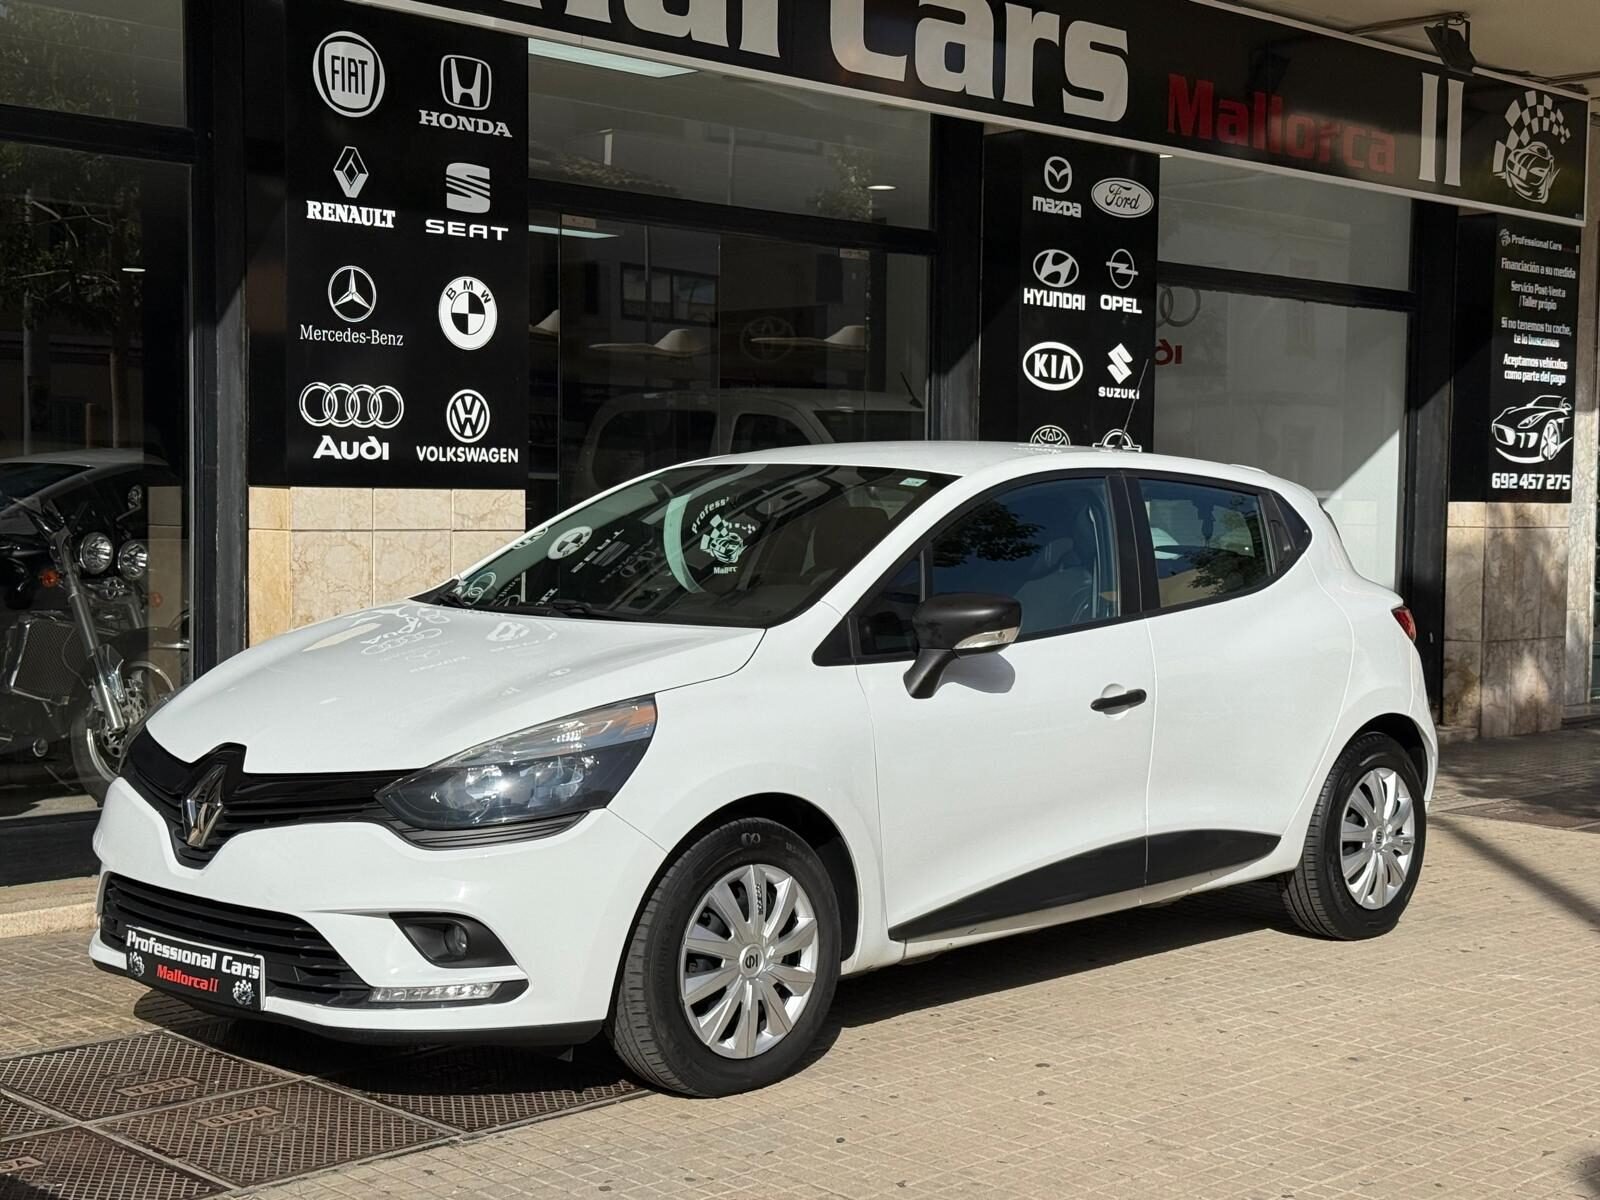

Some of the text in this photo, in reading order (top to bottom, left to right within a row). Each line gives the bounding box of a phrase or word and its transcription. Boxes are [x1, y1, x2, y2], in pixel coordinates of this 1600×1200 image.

[830, 0, 1128, 122] Cars
[331, 55, 368, 95] FIAT
[418, 110, 512, 138] HONDA
[1167, 74, 1395, 174] Mallorca
[1105, 183, 1141, 210] Ford
[306, 200, 396, 228] RENAULT
[425, 219, 509, 241] SEAT
[1512, 234, 1548, 249] Professional
[1540, 265, 1545, 275] a
[1545, 266, 1553, 275] su
[1553, 266, 1576, 279] medida
[1511, 280, 1534, 293] Servicio
[1023, 288, 1086, 311] HYUNDAI
[1100, 294, 1143, 314] OPEL
[1522, 295, 1538, 308] Taller
[1538, 298, 1557, 312] propio
[300, 324, 404, 346] Mercedes-Benz
[1501, 316, 1508, 328] Si
[1508, 319, 1516, 329] no
[1517, 320, 1544, 332] tenemos
[1545, 322, 1552, 333] tu
[1034, 352, 1074, 380] KIA
[1503, 353, 1539, 368] Aceptamos
[1504, 370, 1566, 386] como parte del pago
[1098, 386, 1140, 400] SUZUKI
[313, 435, 390, 461] Audi
[416, 445, 519, 464] VOLKSWAGEN
[1491, 472, 1571, 490] 692 457 275
[126, 930, 260, 979] Professional Cars
[157, 964, 208, 990] Mallorca
